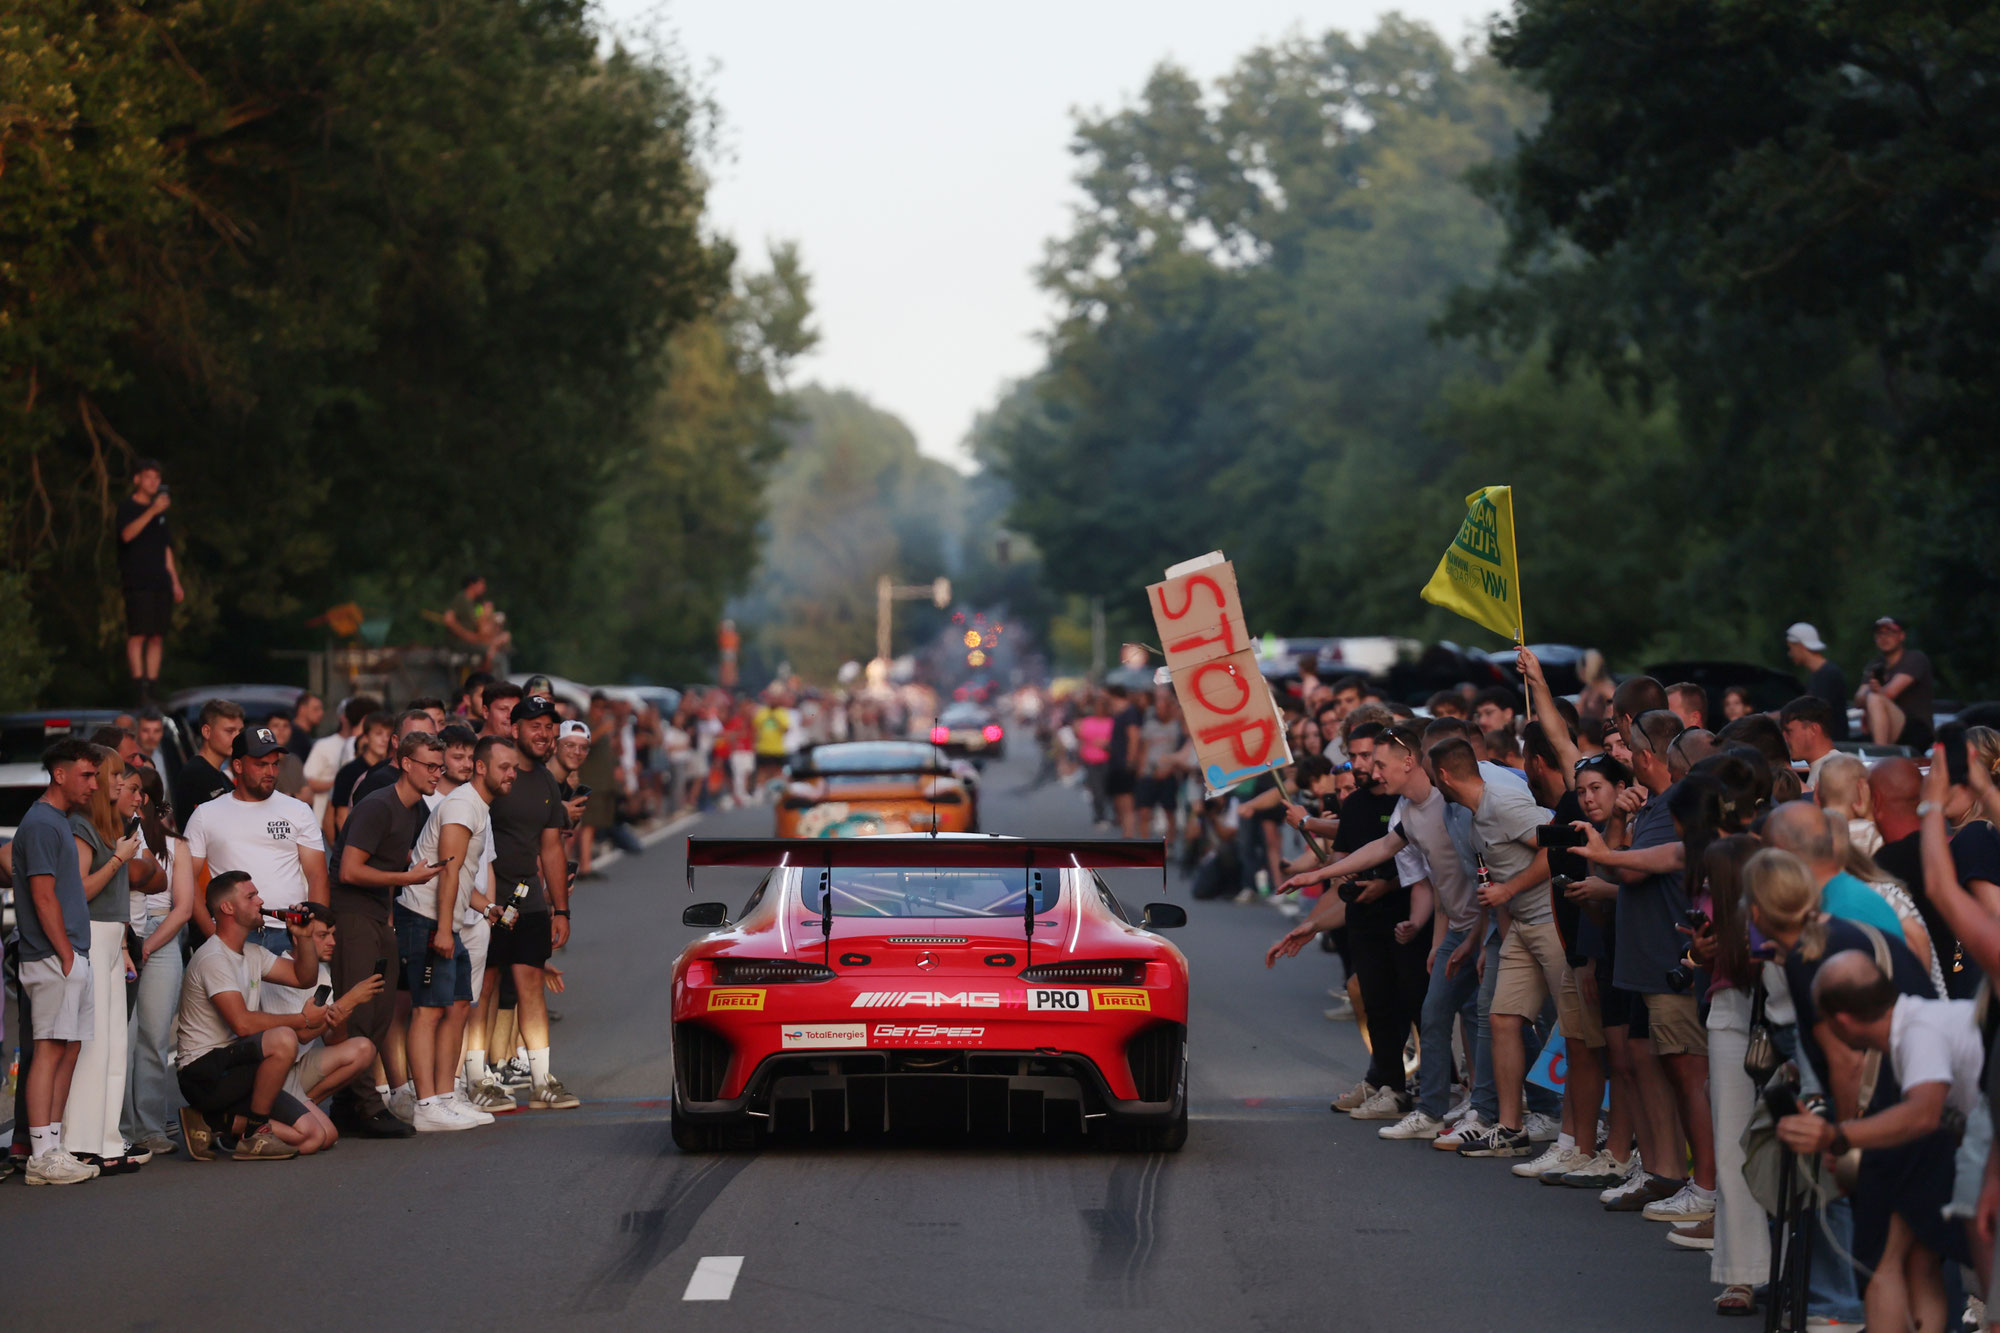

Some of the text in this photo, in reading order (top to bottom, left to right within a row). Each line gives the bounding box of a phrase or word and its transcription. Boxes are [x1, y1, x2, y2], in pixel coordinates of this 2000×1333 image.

[1158, 575, 1275, 766] STOP
[712, 993, 760, 1006] PIRELLI
[897, 992, 1000, 1008] AMG
[1006, 989, 1026, 1009] 17
[1036, 990, 1080, 1009] PRO
[1097, 992, 1146, 1007] PIRELLI
[805, 1031, 865, 1040] TotalEnergies
